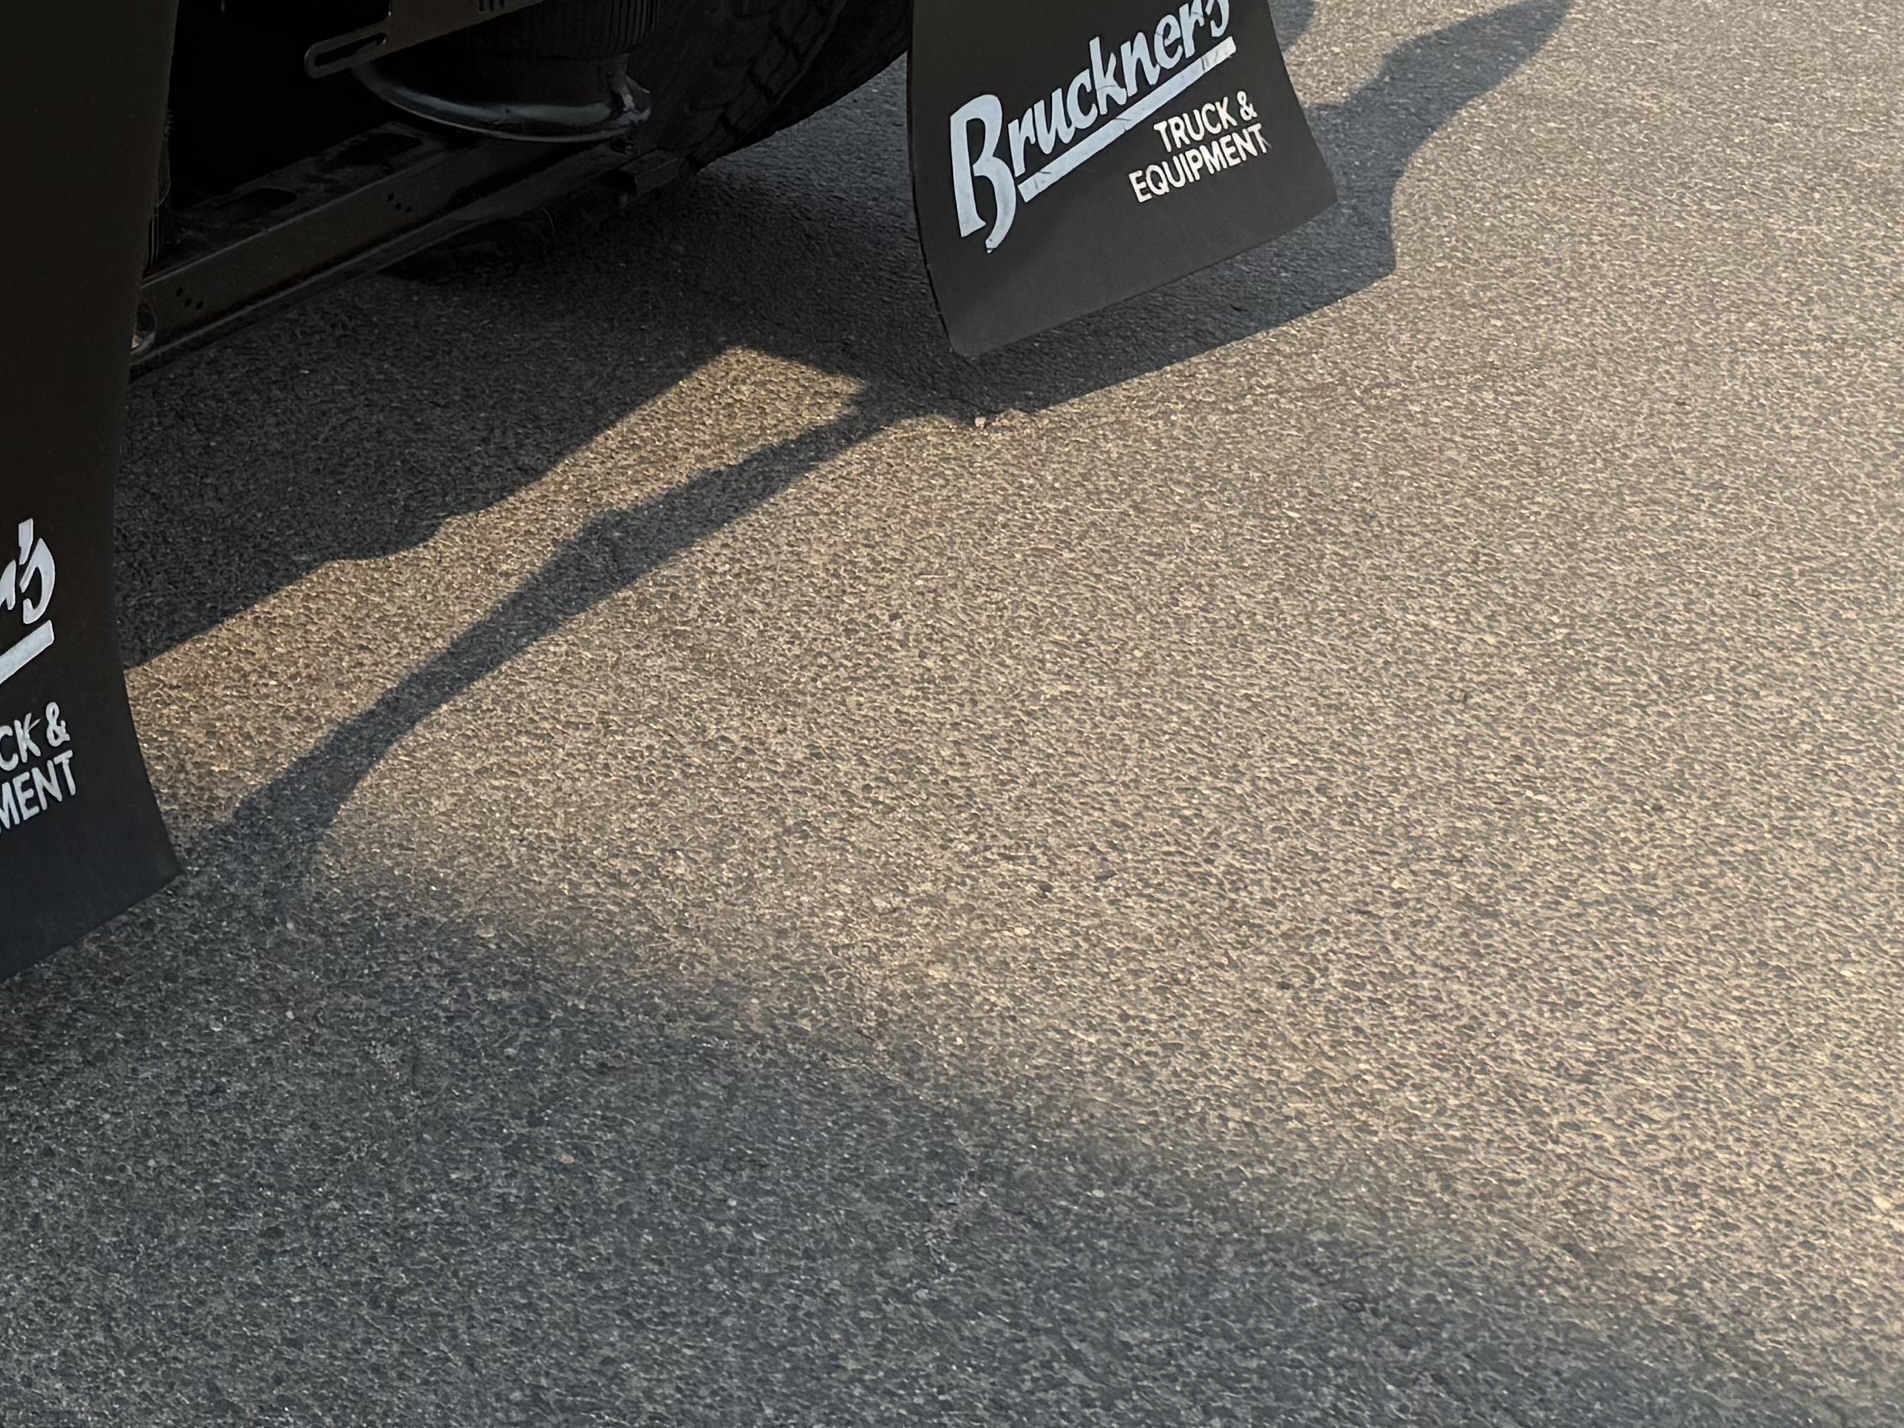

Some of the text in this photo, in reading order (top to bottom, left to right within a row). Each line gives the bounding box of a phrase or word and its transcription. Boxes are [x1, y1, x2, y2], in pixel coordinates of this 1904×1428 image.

[1154, 90, 1258, 154] TRUCK &
[1128, 123, 1269, 204] EQUIPMENT
[45, 701, 71, 747] &
